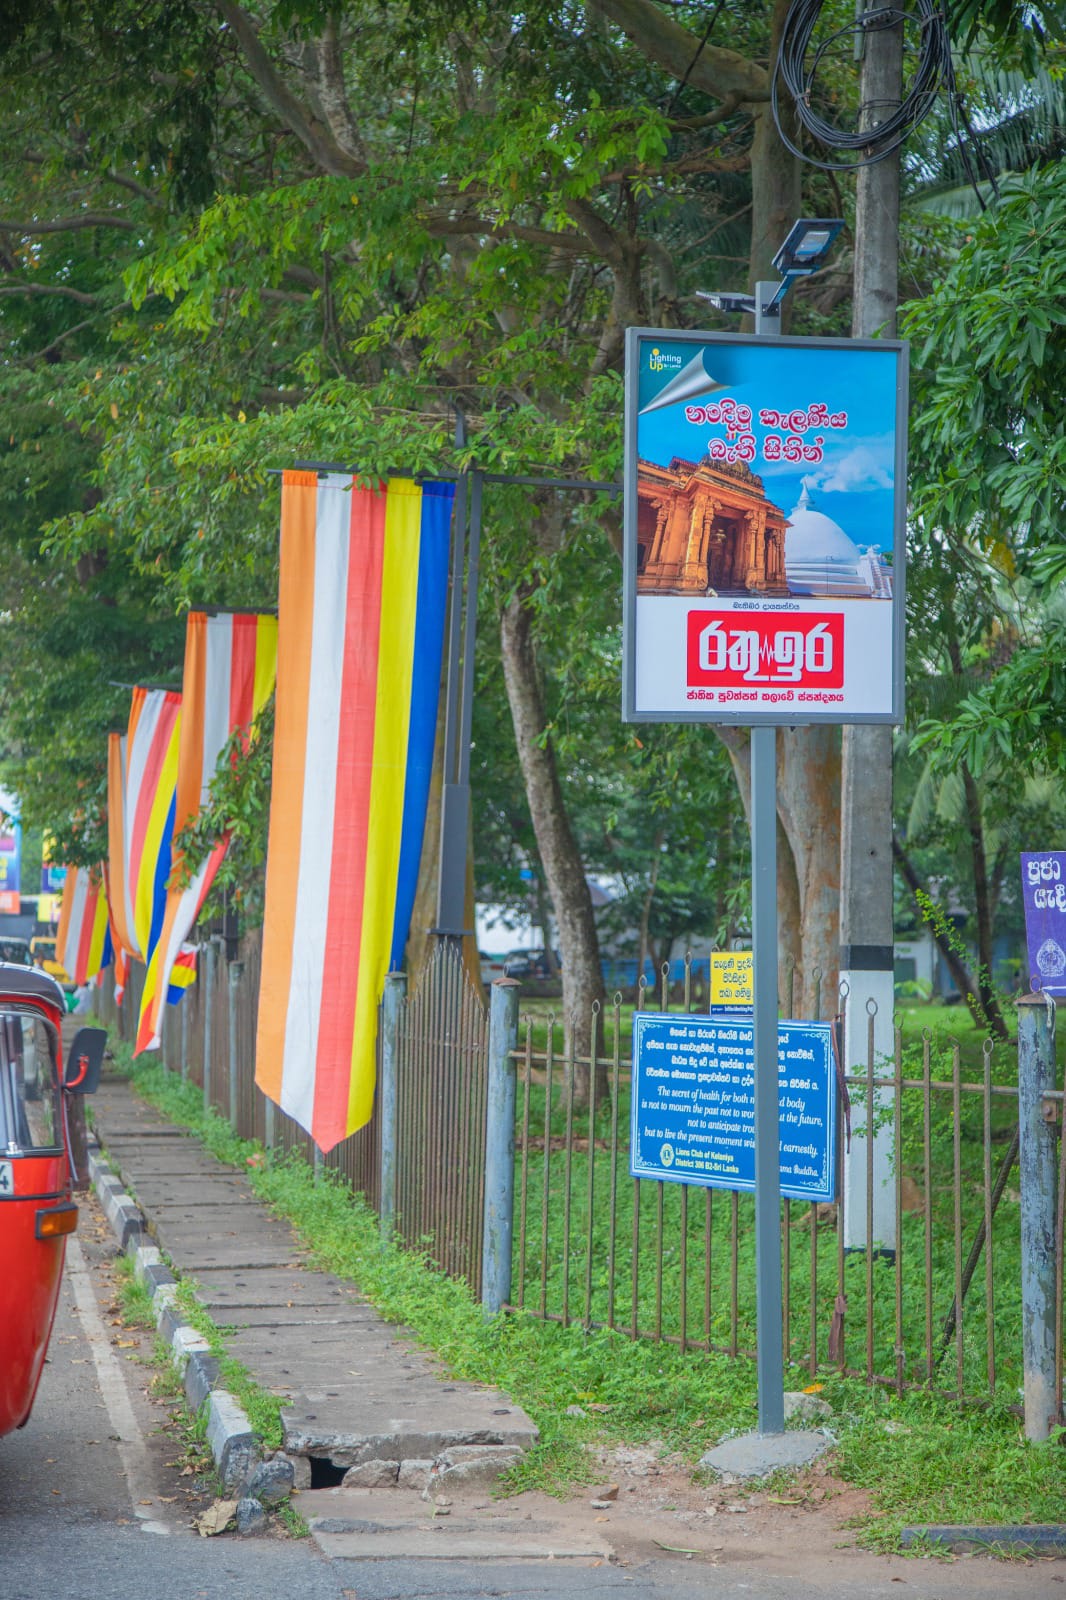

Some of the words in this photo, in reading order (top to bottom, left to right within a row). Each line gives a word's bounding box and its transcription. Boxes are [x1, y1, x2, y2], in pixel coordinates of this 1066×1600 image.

[650, 350, 682, 364] Lighting
[650, 361, 663, 372] Up
[709, 435, 756, 463] බැති
[764, 435, 824, 463] සිතින්
[687, 689, 715, 701] ජාතික
[761, 690, 795, 703] කලාවේ
[658, 1085, 670, 1097] The
[671, 1089, 690, 1098] secret
[691, 1088, 699, 1102] of
[699, 1089, 720, 1102] health
[720, 1091, 731, 1104] for
[732, 1092, 749, 1104] both
[786, 1096, 806, 1112] body
[641, 1098, 647, 1108] is
[648, 1100, 660, 1109] not
[660, 1101, 668, 1110] to
[668, 1103, 691, 1113] mourn
[692, 1103, 703, 1114] the
[704, 1106, 719, 1117] past
[720, 1107, 731, 1117] not
[733, 1108, 740, 1117] to
[741, 1109, 754, 1119] wor
[786, 1112, 798, 1123] the
[798, 1113, 823, 1127] future,
[688, 1119, 698, 1128] not
[700, 1120, 706, 1129] to
[708, 1120, 741, 1133] anticipate
[644, 1126, 655, 1137] but
[656, 1129, 663, 1138] to
[664, 1128, 676, 1139] live
[677, 1130, 687, 1140] the
[688, 1133, 713, 1144] present
[714, 1136, 742, 1147] moment
[675, 1147, 690, 1157] Lions
[691, 1149, 703, 1158] Club
[704, 1151, 711, 1159] of
[711, 1151, 734, 1163] Kelaniya
[675, 1158, 694, 1169] District
[722, 1164, 740, 1174] Lanka
